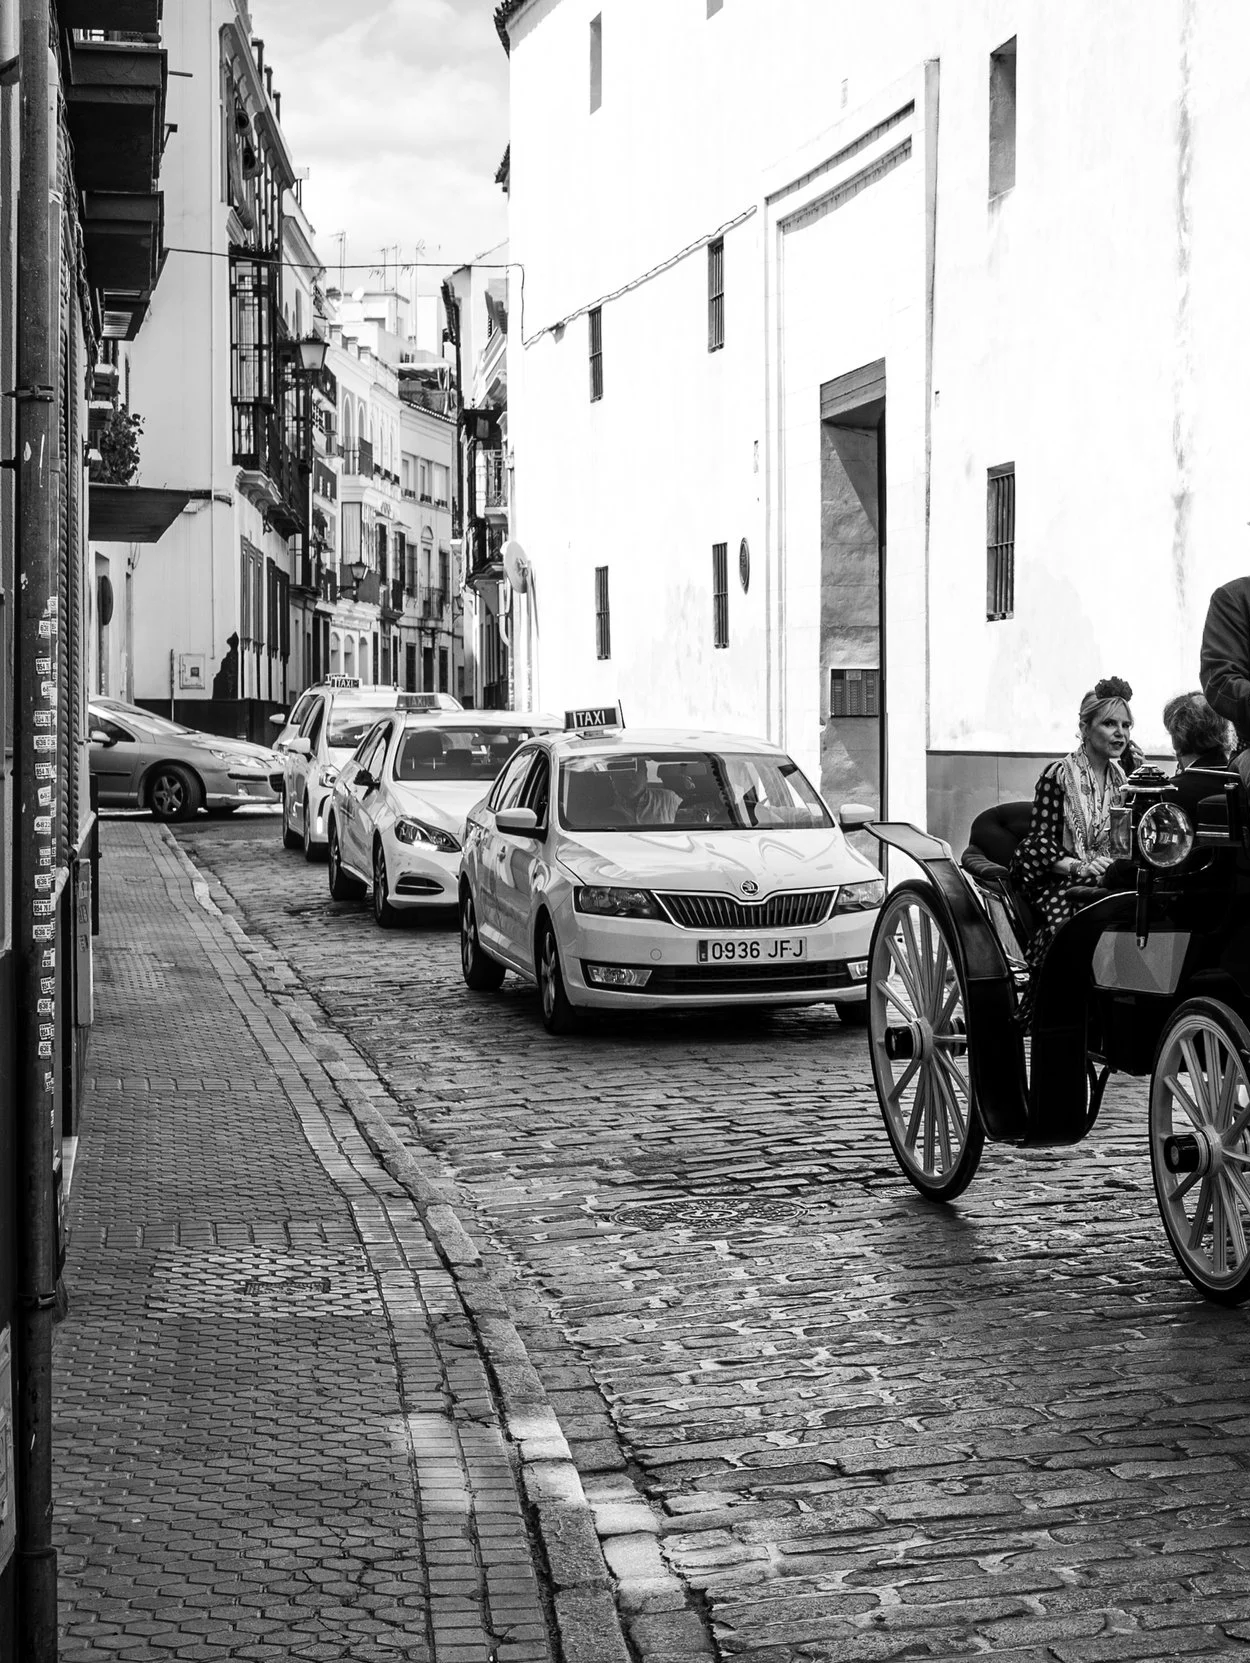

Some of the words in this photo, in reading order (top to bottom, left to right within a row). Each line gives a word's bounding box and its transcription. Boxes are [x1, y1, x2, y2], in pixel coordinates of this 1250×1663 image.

[337, 679, 353, 688] TAXI
[576, 710, 606, 726] TAXI
[712, 941, 760, 960] 0936
[768, 939, 803, 958] JFJ
